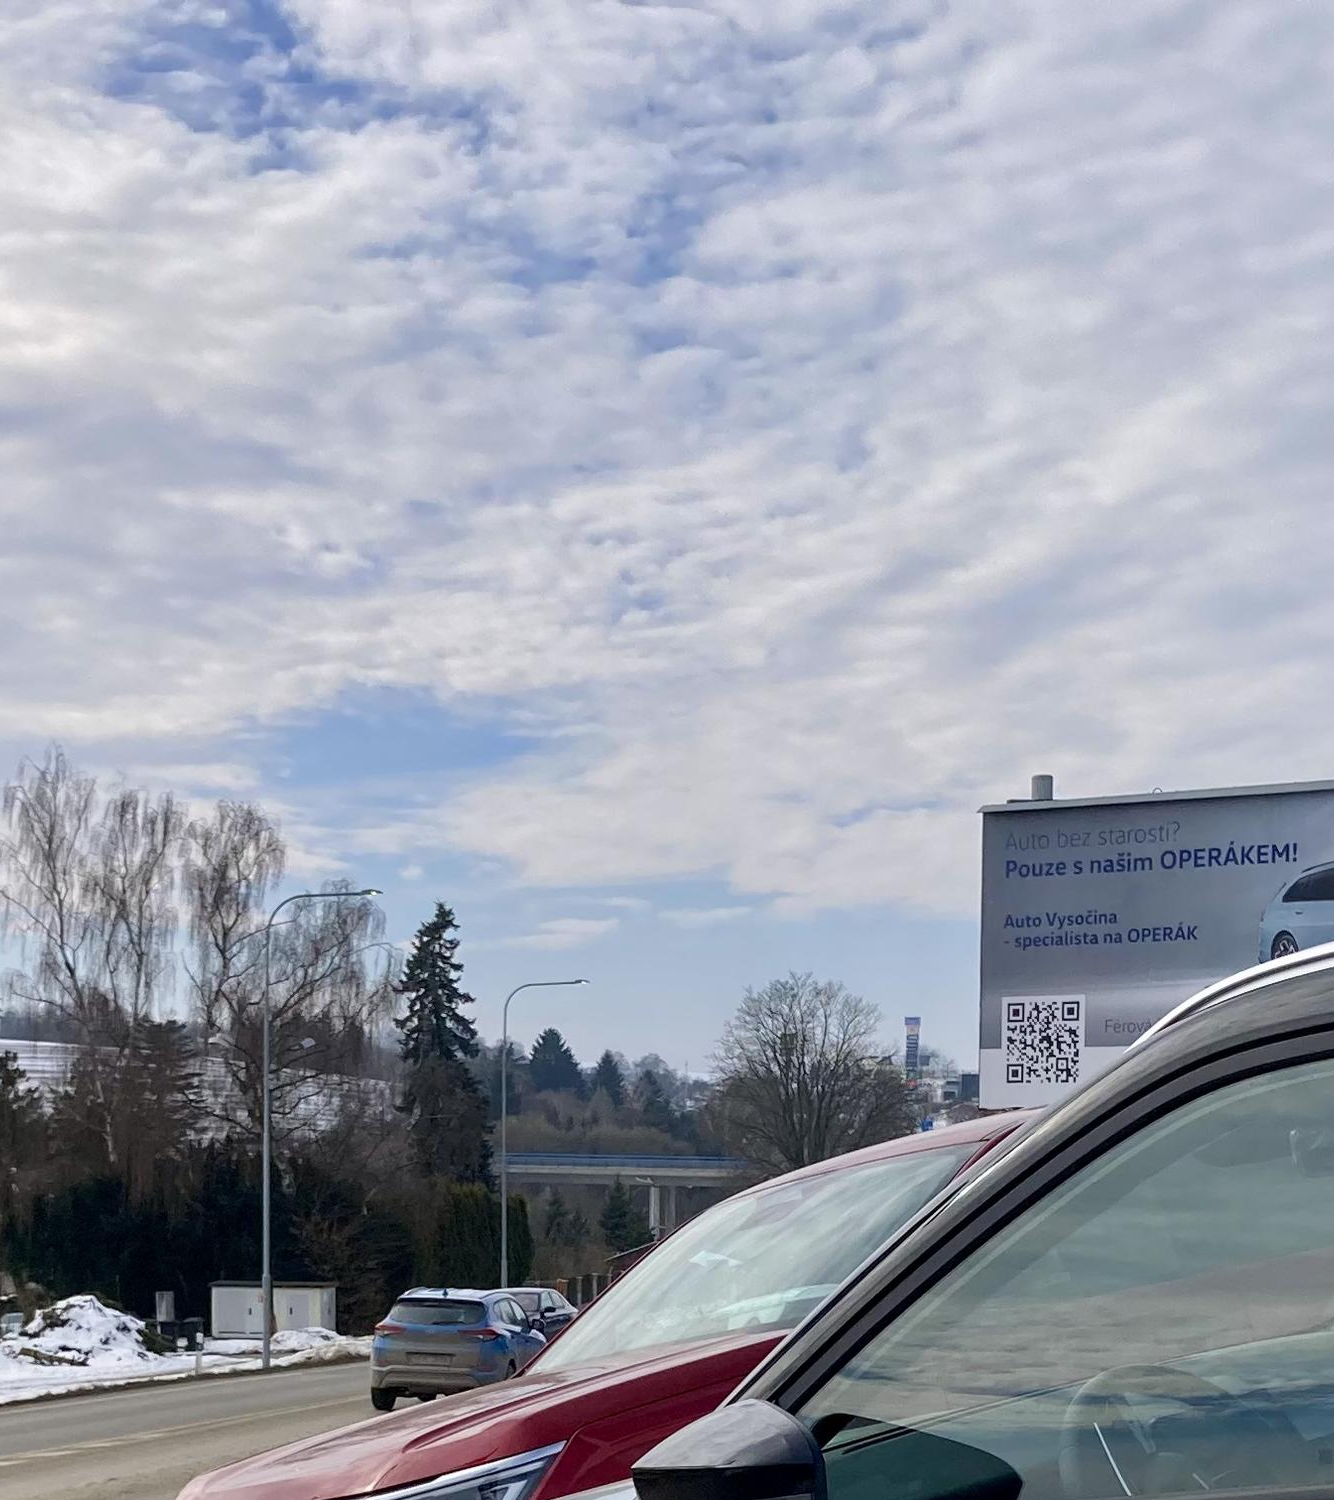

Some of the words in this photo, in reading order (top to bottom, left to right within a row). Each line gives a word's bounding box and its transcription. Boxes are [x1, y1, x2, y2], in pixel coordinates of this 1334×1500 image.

[1005, 832, 1050, 851] Auto
[1057, 828, 1091, 848] bez
[1098, 822, 1181, 846] starosti?
[1005, 859, 1067, 879] Pouze
[1073, 860, 1083, 875] s
[1090, 852, 1154, 875] našim
[1161, 841, 1299, 870] OPERÁKEM!
[1003, 914, 1042, 929] Auto
[1045, 910, 1118, 930] Vysočina
[1014, 930, 1099, 950] specialista
[1103, 929, 1123, 944] na
[1127, 922, 1199, 943] OPERÁK
